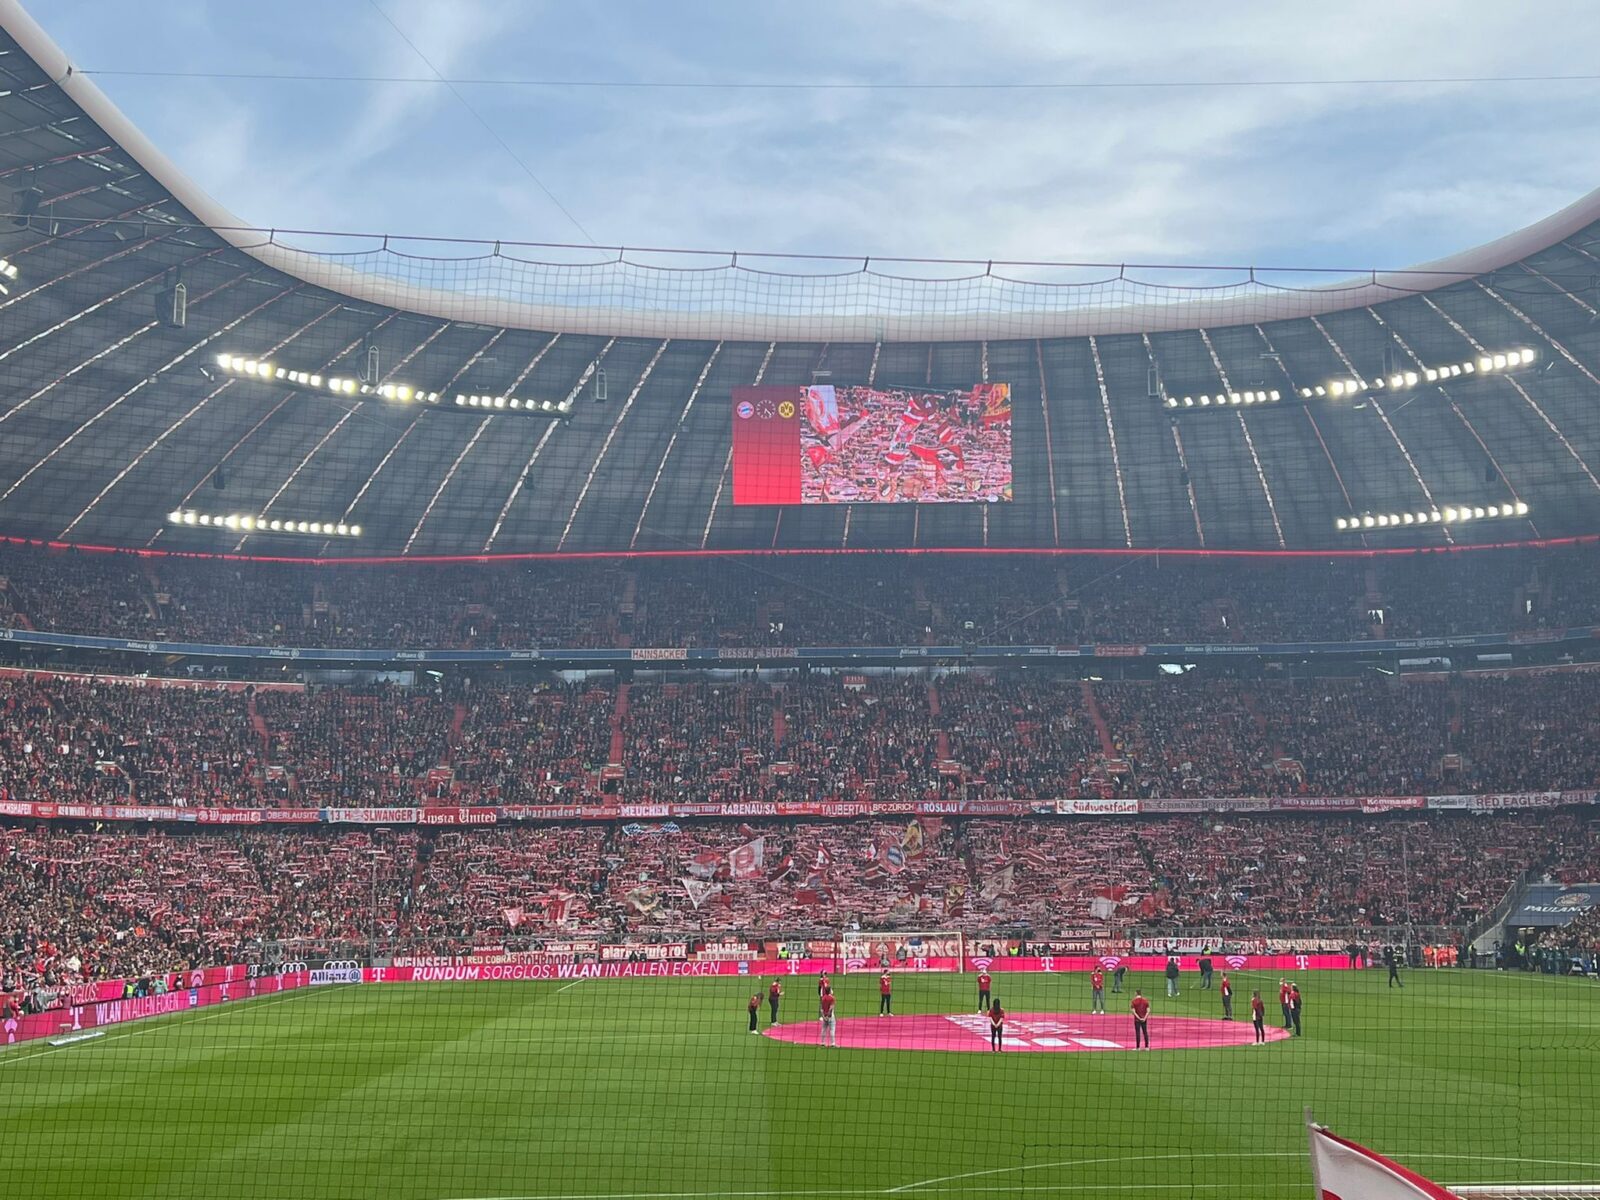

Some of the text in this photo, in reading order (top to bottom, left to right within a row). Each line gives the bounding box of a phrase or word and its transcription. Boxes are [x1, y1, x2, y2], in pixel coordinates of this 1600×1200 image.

[396, 651, 417, 659] Allianz
[510, 651, 530, 659] Allianz
[633, 649, 686, 660] HAINSACKER
[1073, 800, 1137, 813] Südwestfalen
[1476, 795, 1550, 807] RED EAGLES
[267, 810, 319, 820] OBERLAUSITZ
[620, 805, 669, 816] MEUCHEN
[1524, 904, 1597, 913] PAULAN
[1176, 938, 1219, 949] BRETTEN
[669, 944, 687, 957] rot
[467, 954, 517, 965] RED COBRAS
[310, 969, 347, 982] Allianz
[412, 961, 720, 981] RUNDUM SORGLOS: WLAN IN ALLEN ECKEN
[96, 1000, 121, 1026] WLAN
[130, 996, 156, 1018] ALLEN
[157, 992, 179, 1014] ECKEN
